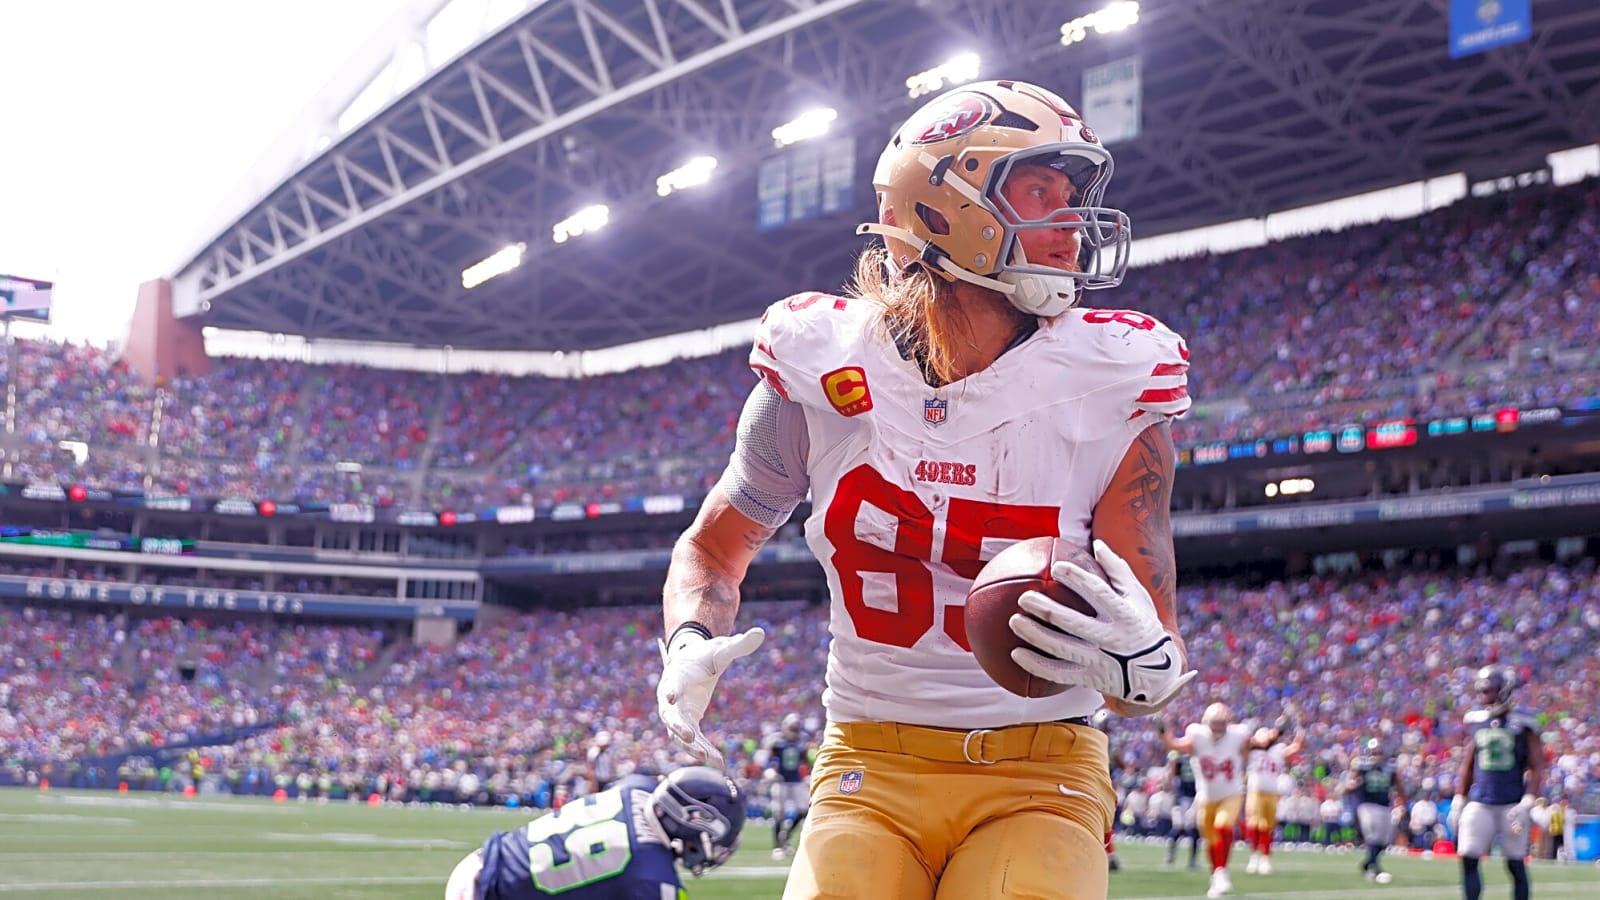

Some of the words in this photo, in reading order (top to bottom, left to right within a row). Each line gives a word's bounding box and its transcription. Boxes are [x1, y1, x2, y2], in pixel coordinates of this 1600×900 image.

[826, 369, 866, 407] C
[926, 408, 945, 421] NFL
[914, 460, 977, 487] 49ERS
[824, 463, 1061, 652] 85
[26, 580, 110, 602] HOME
[130, 586, 165, 605] OF
[186, 589, 238, 611] THE
[840, 780, 861, 792] NFL
[527, 785, 632, 895] 39
